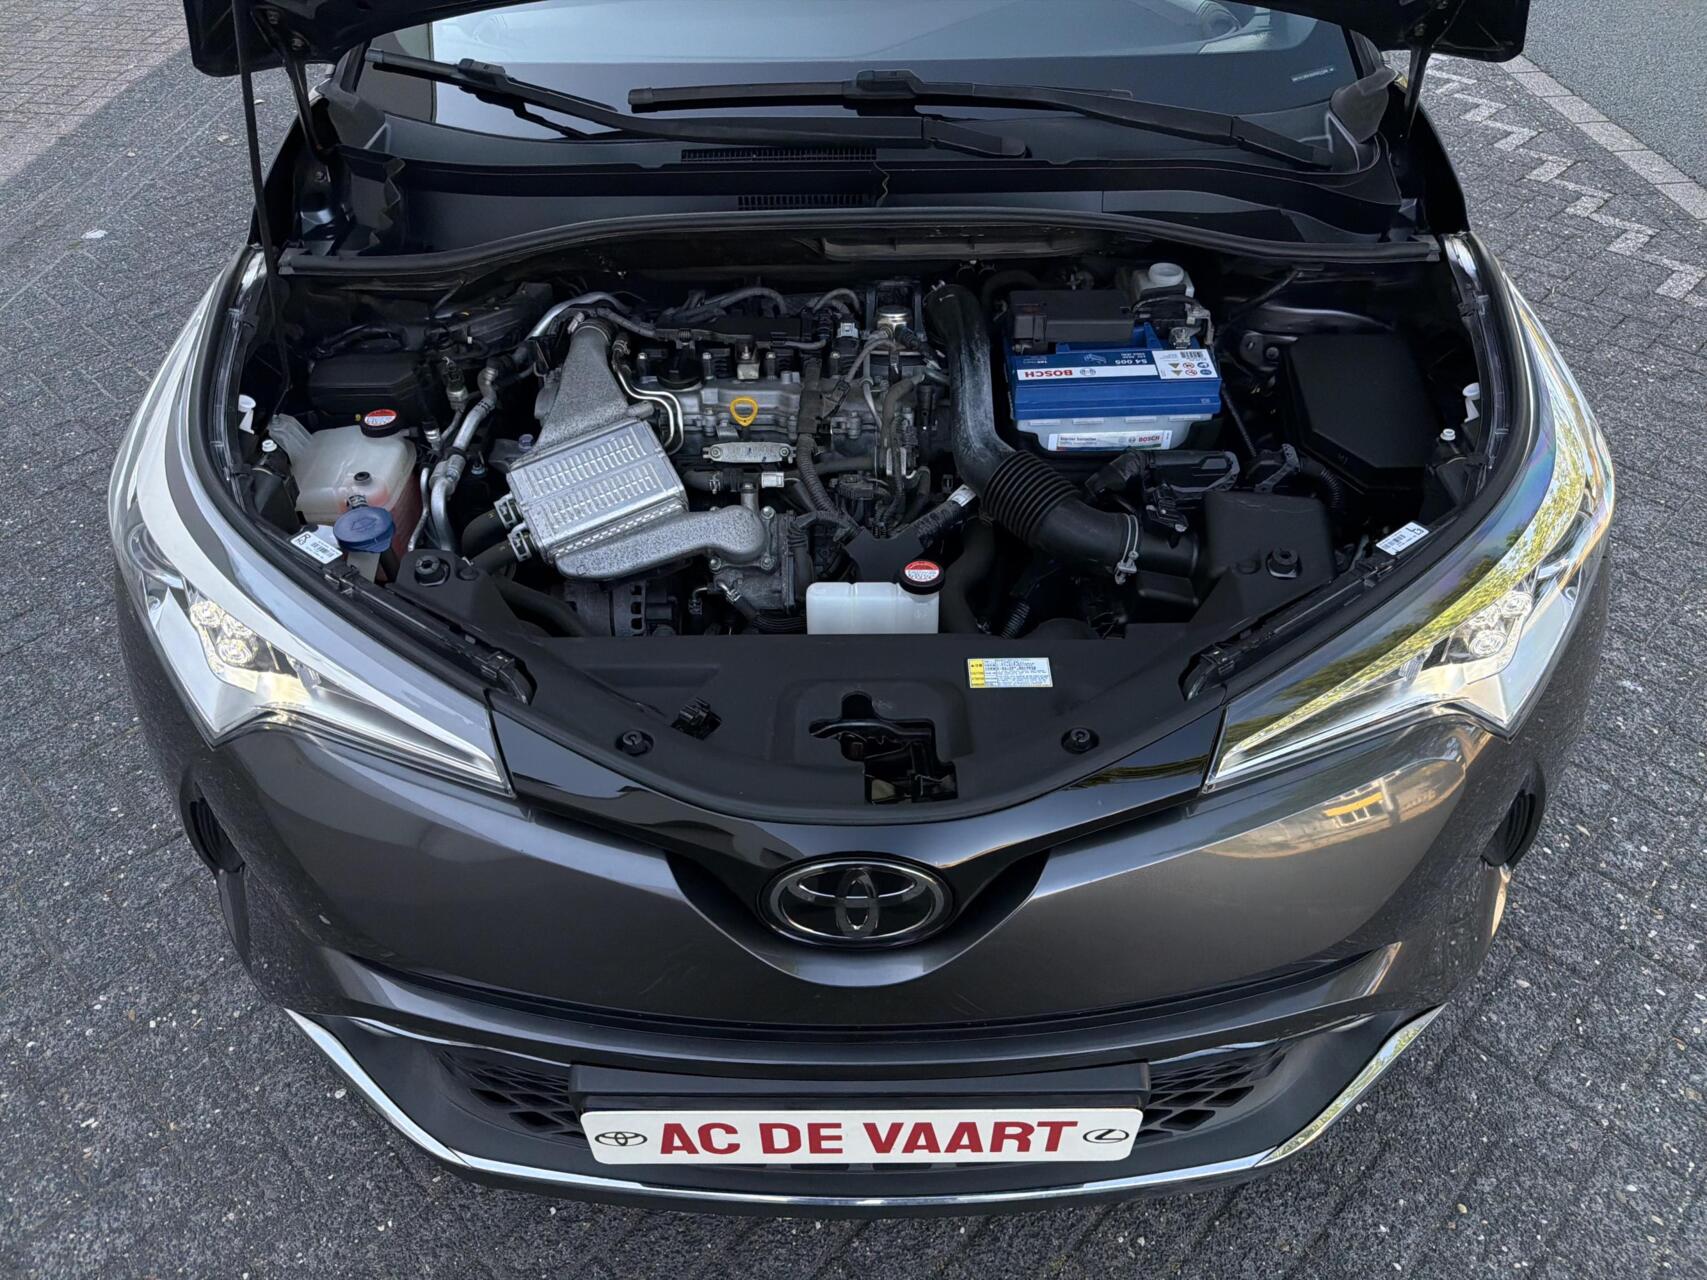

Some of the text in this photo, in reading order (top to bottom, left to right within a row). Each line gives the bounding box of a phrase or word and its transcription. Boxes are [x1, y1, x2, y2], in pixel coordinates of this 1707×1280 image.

[1024, 369, 1073, 378] BOSCH
[1138, 435, 1160, 443] BOSCH
[660, 1121, 1078, 1155] AC DE VAART
